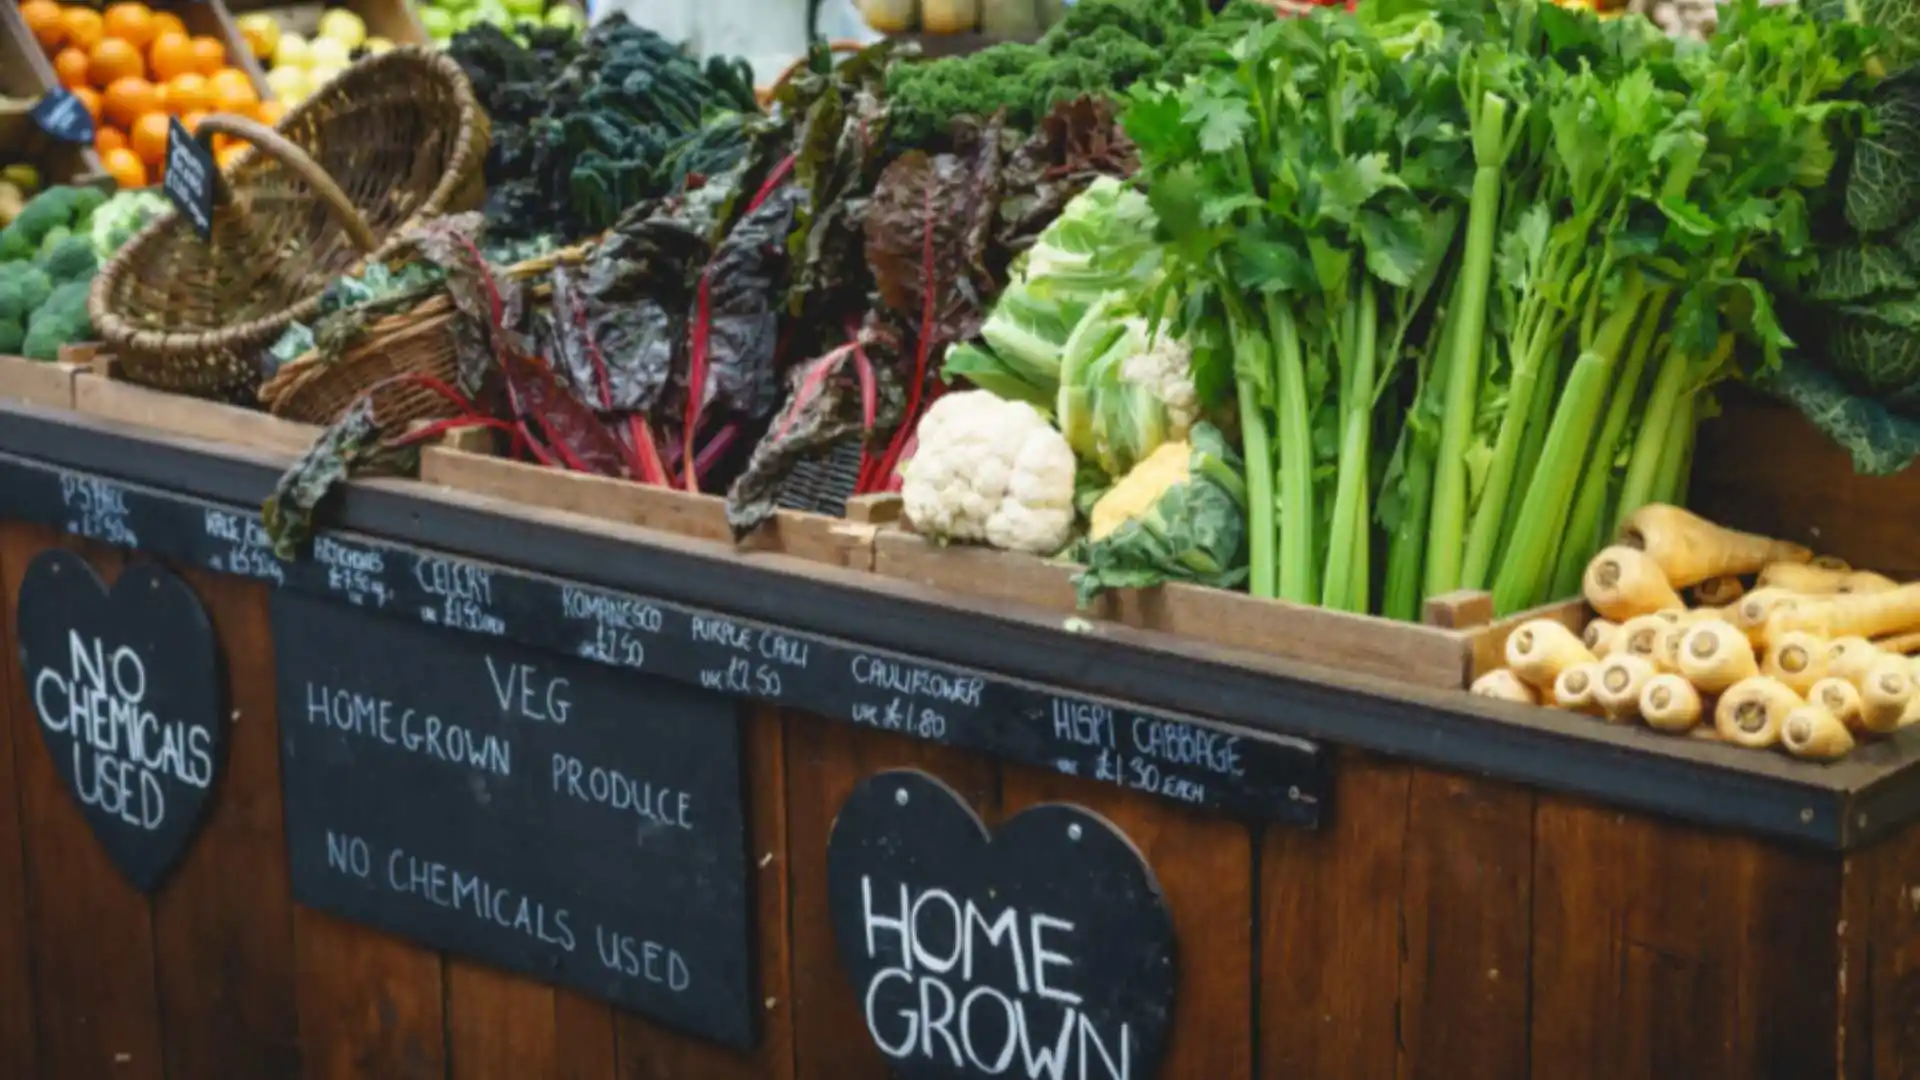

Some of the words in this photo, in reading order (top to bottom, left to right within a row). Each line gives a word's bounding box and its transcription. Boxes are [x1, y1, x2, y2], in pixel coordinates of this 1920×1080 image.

[415, 555, 492, 607] CELERY
[69, 627, 145, 703] NO
[692, 616, 752, 652] PURPLE
[758, 628, 809, 669] CAULI
[851, 653, 986, 707] CAULIFLOWER
[36, 667, 211, 788] CHEMICALS
[485, 653, 572, 725] VEG
[306, 681, 511, 775] HOMEGROWN
[551, 752, 694, 830] PRODUCE
[1053, 698, 1116, 747] HISPI
[1131, 716, 1246, 777] CABBAGE
[73, 740, 164, 830] USED
[326, 829, 370, 878] NO
[387, 848, 576, 952] CHEMICALS
[596, 924, 691, 992] USED
[861, 873, 1084, 1004] HOME
[865, 966, 1131, 1080] GROWN
